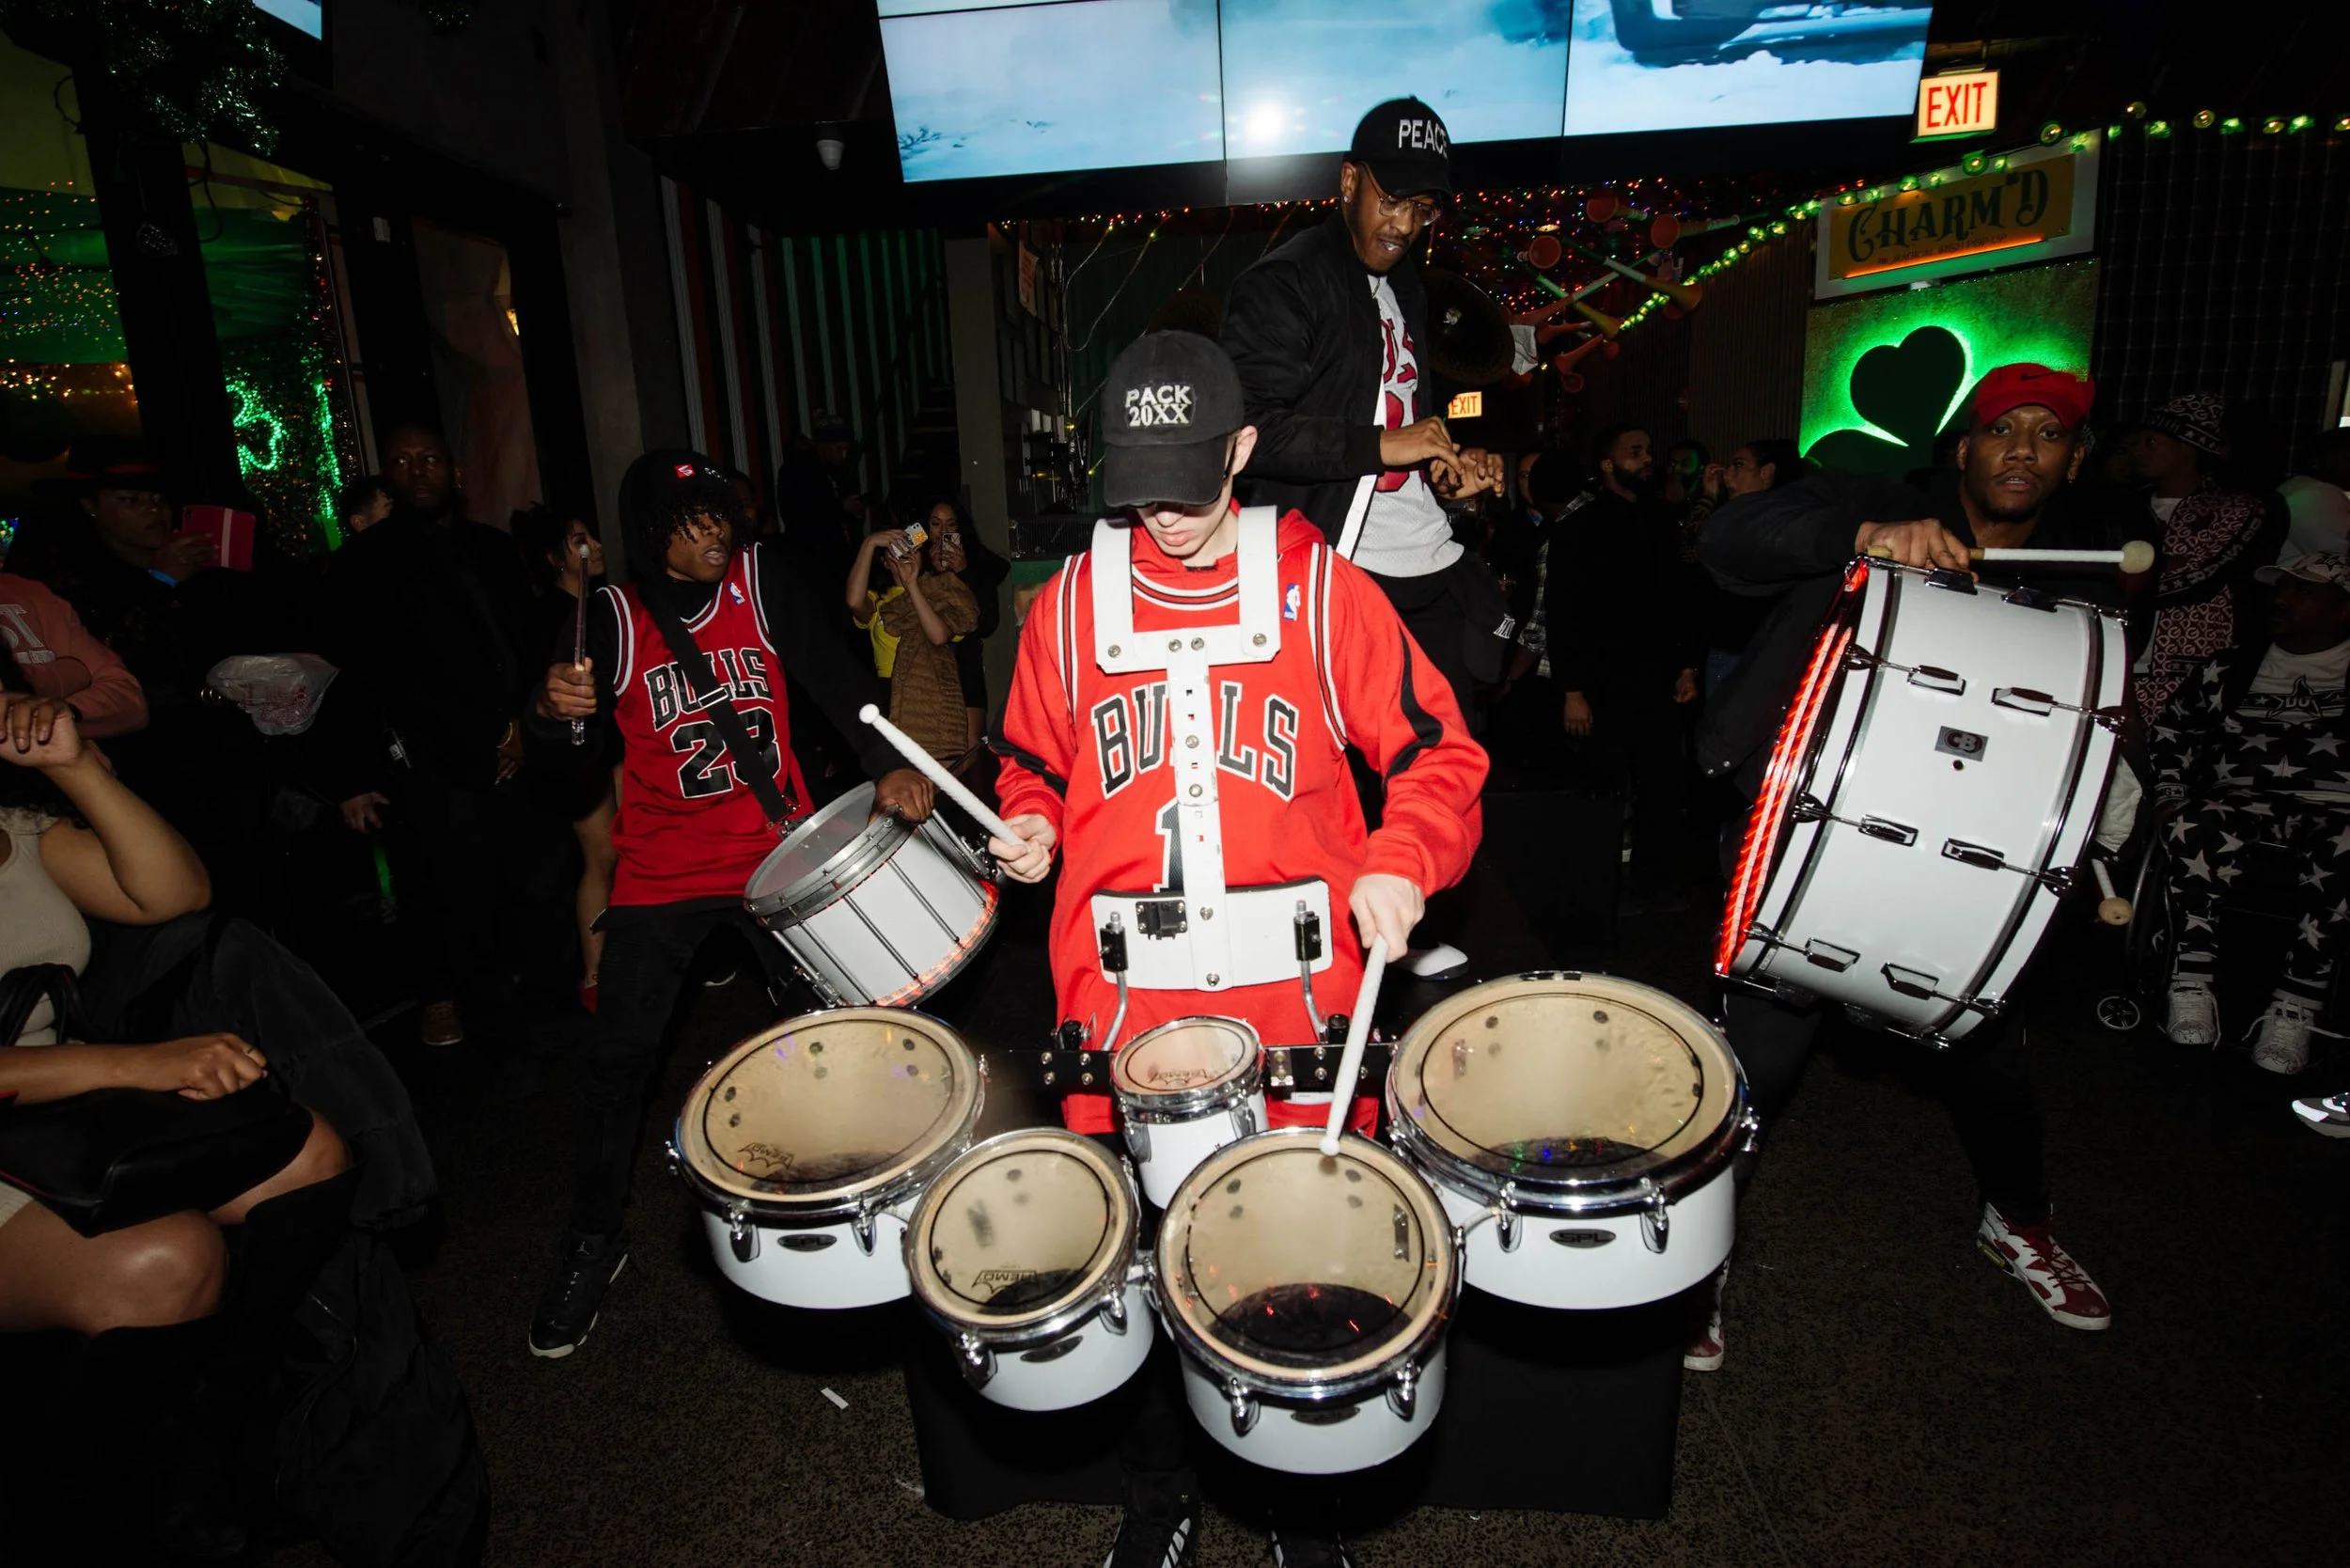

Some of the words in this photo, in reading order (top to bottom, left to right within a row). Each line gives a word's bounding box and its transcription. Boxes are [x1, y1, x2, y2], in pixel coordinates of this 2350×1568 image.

[1927, 82, 1987, 128] EXIT
[1125, 384, 1192, 408] PACK
[1450, 395, 1478, 416] EXIT
[1128, 403, 1189, 427] 20XX
[644, 647, 774, 732] BULS
[1090, 680, 1299, 802] BULS
[1557, 1232, 1613, 1243] SPL
